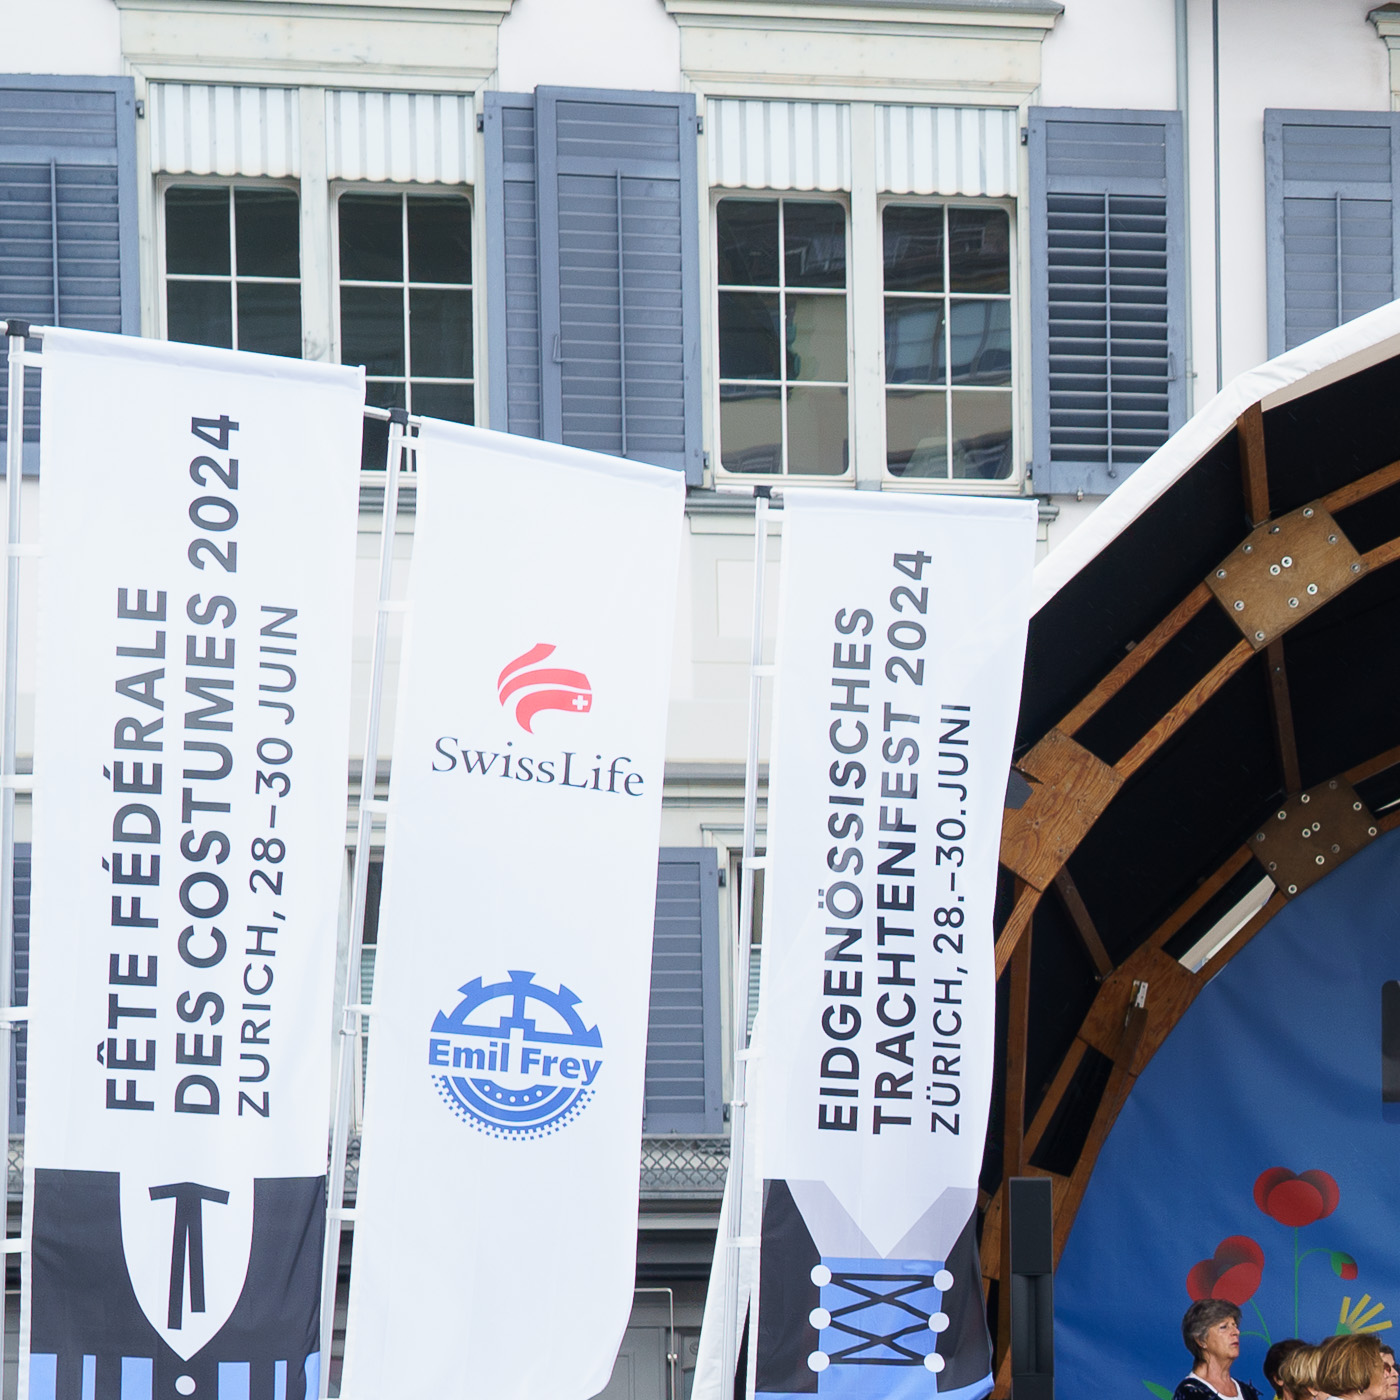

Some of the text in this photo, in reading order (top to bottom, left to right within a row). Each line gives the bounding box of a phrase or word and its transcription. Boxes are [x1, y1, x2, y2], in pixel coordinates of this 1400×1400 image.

[175, 415, 239, 1115] DES COSTUMES 2024
[259, 606, 297, 725] JUIN
[873, 551, 931, 1135] TRACHTENFEST 2024
[97, 588, 166, 1112] FÊTE FÉDÉRALE
[238, 911, 285, 1117] ZURICH,
[818, 608, 873, 1132] EIDGENÖSSISCHES
[429, 1038, 603, 1086] Emil Frey
[924, 967, 968, 1136] ZÜRICH,
